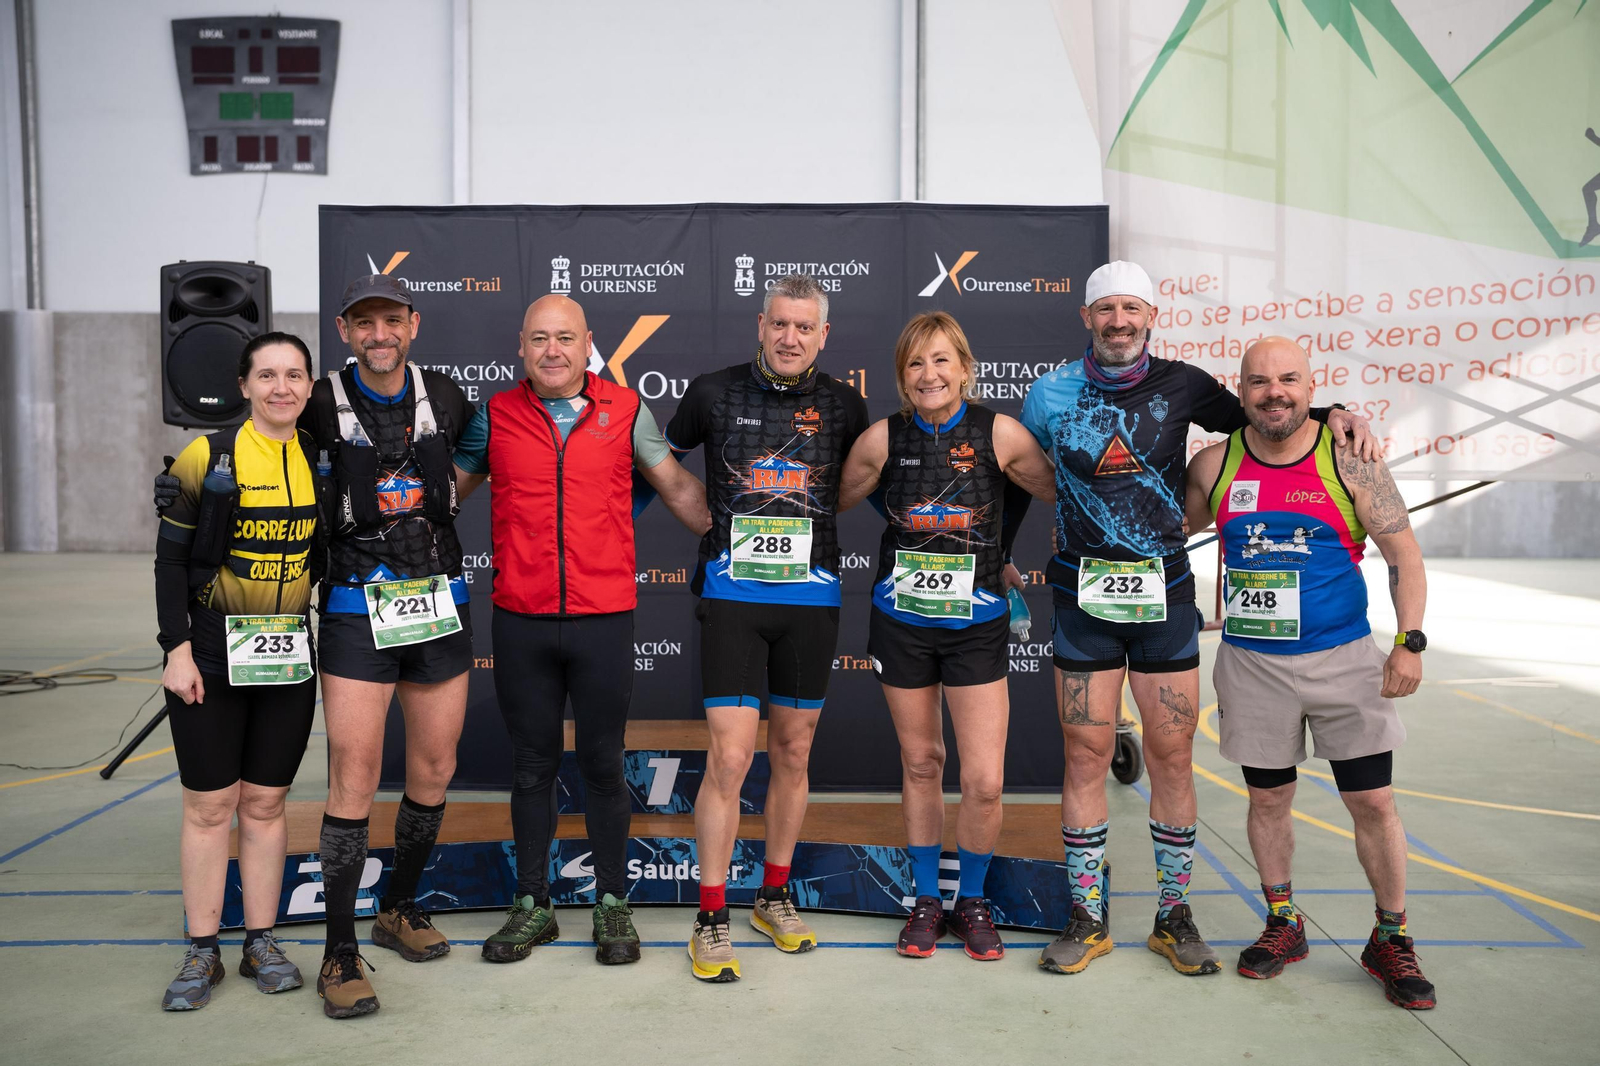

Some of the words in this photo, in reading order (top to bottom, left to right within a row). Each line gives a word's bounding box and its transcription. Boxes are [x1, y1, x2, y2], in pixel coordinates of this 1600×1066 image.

[580, 260, 684, 277] DEPUTACIÓN
[765, 259, 870, 275] DEPUTACIÓN
[580, 280, 657, 293] OURENSE
[962, 276, 1071, 293] OurenseTrail
[1159, 273, 1219, 300] que:
[1201, 305, 1231, 326] se
[1376, 292, 1393, 313] a
[1406, 267, 1596, 311] sensación
[1365, 324, 1441, 348] xera
[1455, 321, 1478, 342] o
[1361, 362, 1454, 385] crear
[1285, 490, 1327, 504] LÓPEZ
[752, 536, 792, 553] 288
[914, 571, 953, 589] 269
[1103, 576, 1143, 593] 232
[394, 596, 431, 617] 221
[1241, 590, 1277, 608] 248
[253, 635, 294, 653] 233
[647, 758, 681, 806] 1
[627, 859, 744, 881] Sauder
